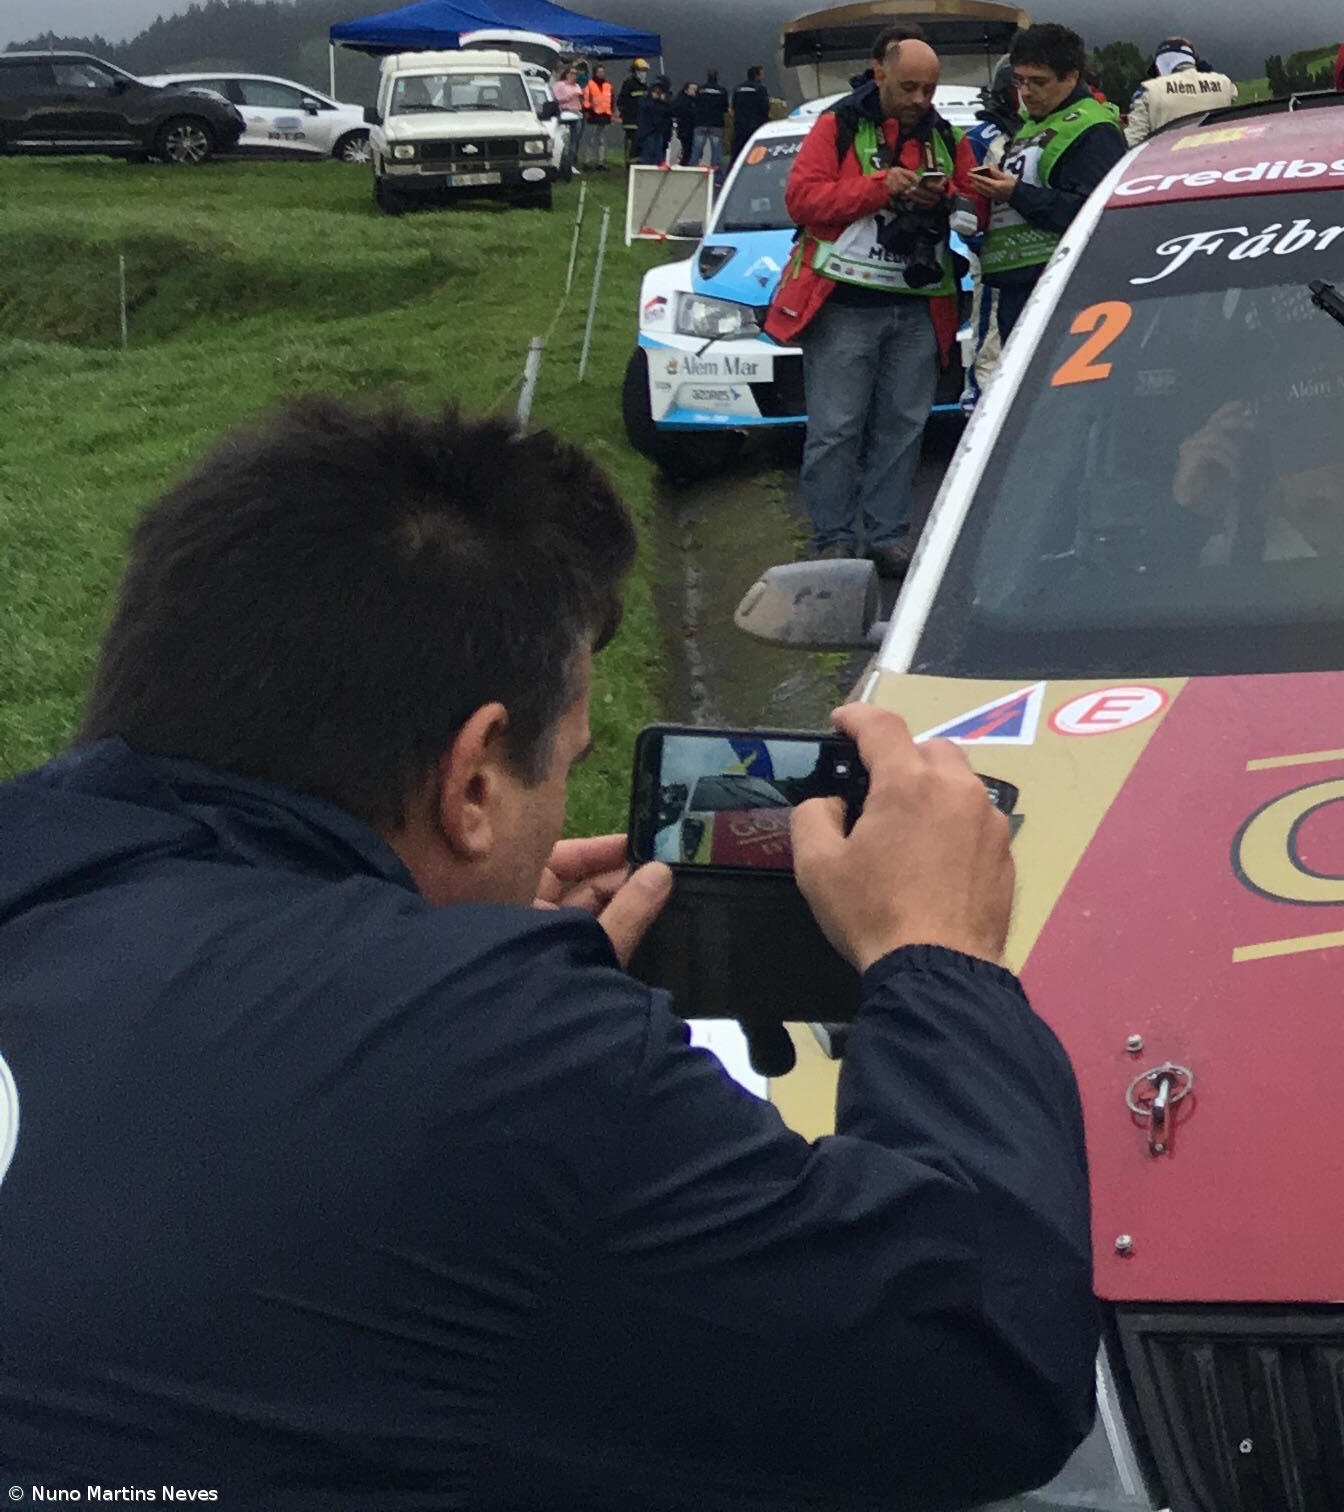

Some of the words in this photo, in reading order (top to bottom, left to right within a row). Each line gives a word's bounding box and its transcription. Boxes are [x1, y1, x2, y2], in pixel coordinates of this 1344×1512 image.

[1166, 80, 1197, 94] Além
[1200, 79, 1222, 94] Mar
[1052, 299, 1134, 388] 2
[723, 356, 760, 376] Mar
[1075, 694, 1146, 725] E
